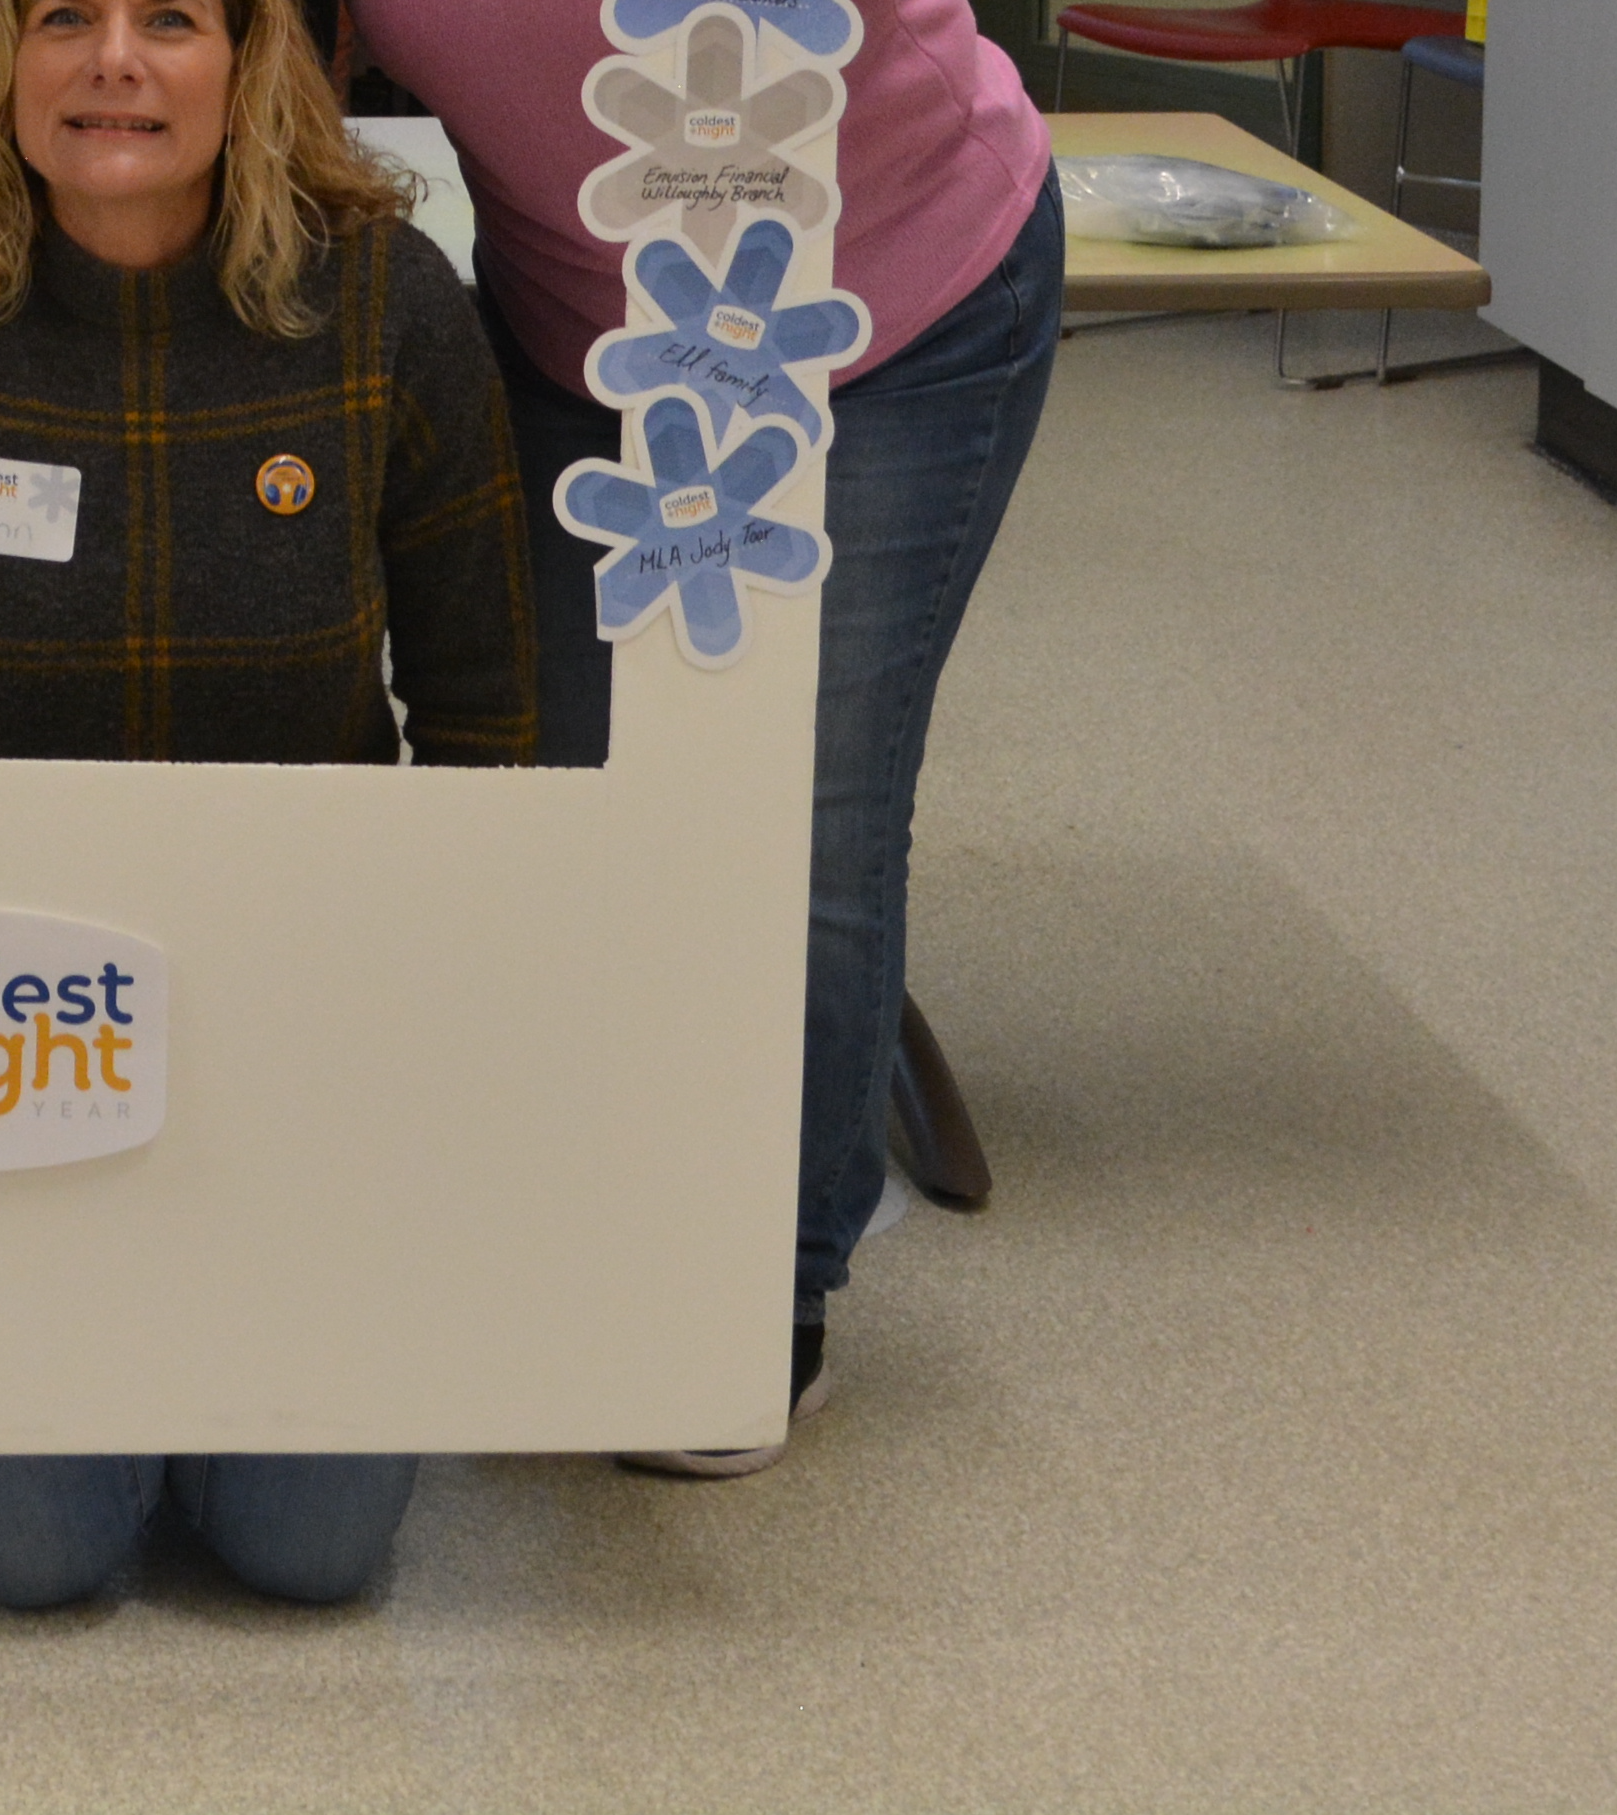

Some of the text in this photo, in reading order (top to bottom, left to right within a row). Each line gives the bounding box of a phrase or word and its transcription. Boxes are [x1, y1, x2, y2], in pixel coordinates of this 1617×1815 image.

[690, 115, 735, 126] coldest
[697, 124, 735, 140] night
[715, 165, 790, 185] Financial
[642, 184, 785, 212] Willoughby Branch
[716, 311, 759, 331] coldest
[721, 321, 757, 342] night
[665, 491, 710, 509] coldest
[675, 499, 712, 518] night
[640, 545, 682, 573] MLA
[691, 530, 731, 567] Jody
[32, 1100, 131, 1120] YEAR
